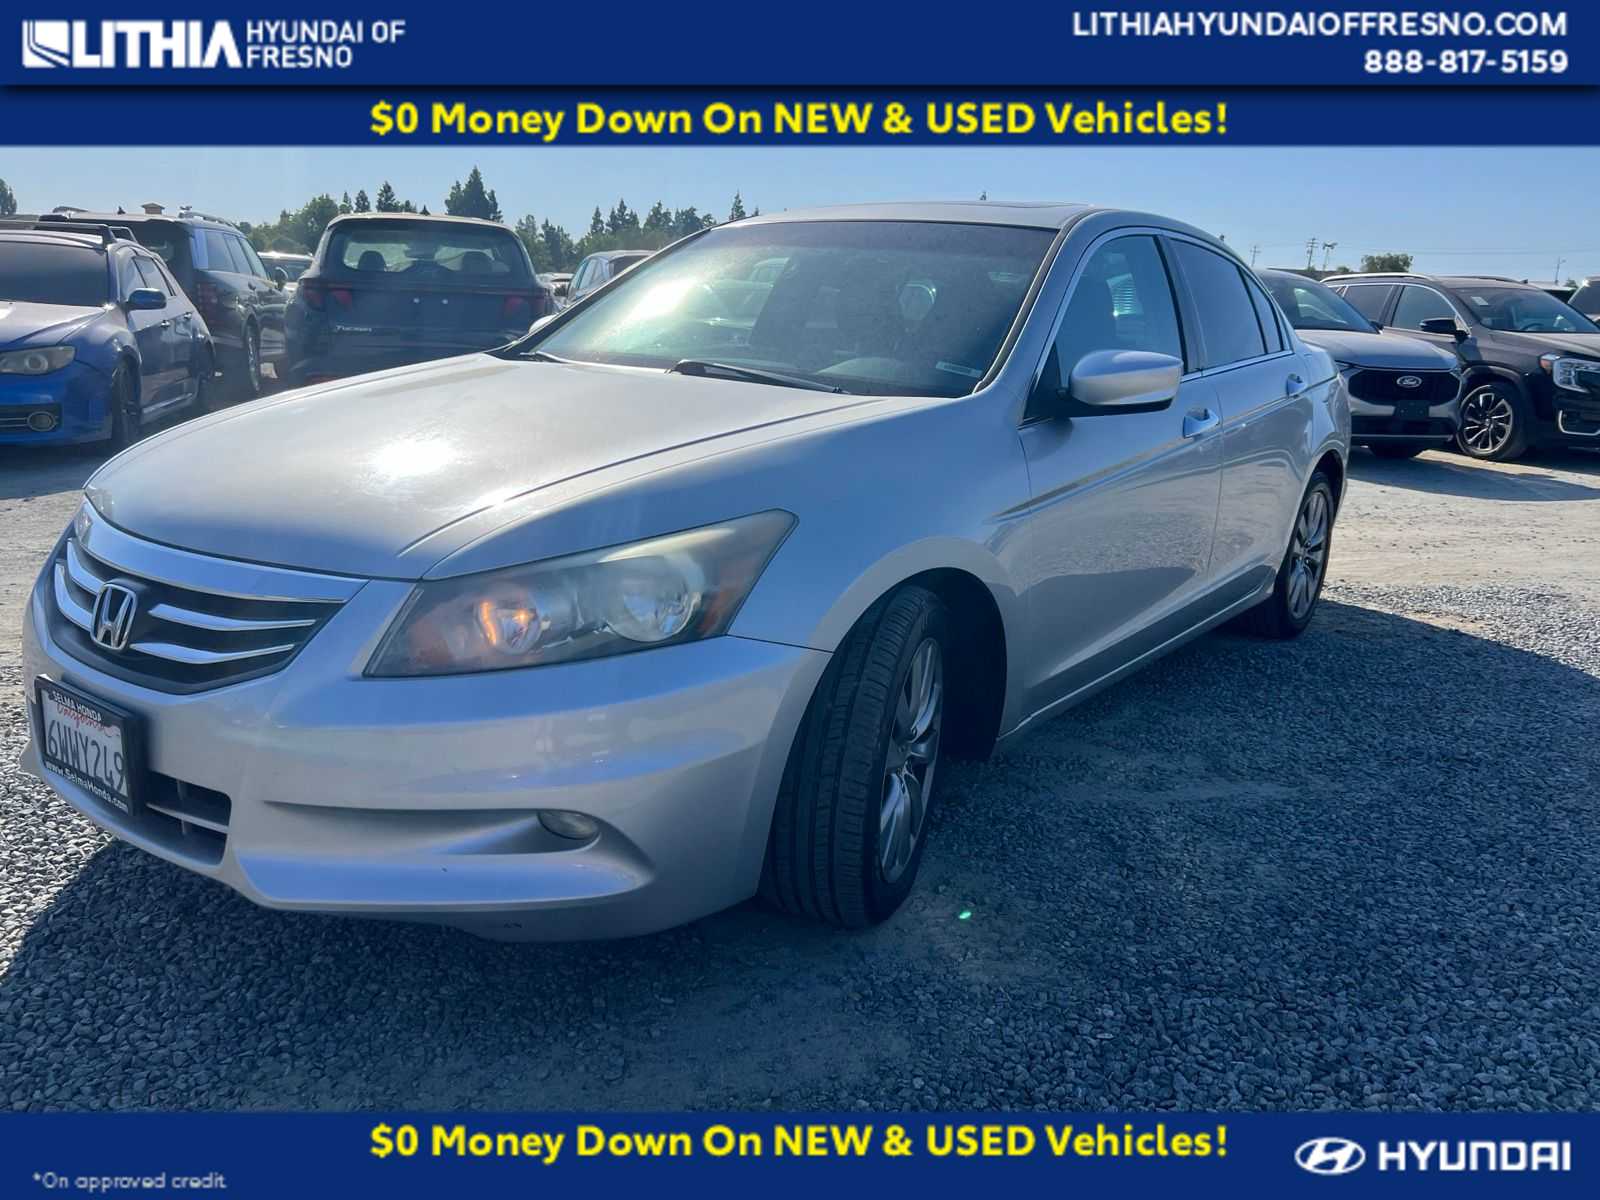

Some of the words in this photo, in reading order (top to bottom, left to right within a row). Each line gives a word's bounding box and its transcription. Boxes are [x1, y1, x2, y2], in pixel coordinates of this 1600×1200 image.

[53, 691, 77, 710] SELMA
[76, 703, 102, 722] HONDA
[48, 719, 125, 792] 6WWY249
